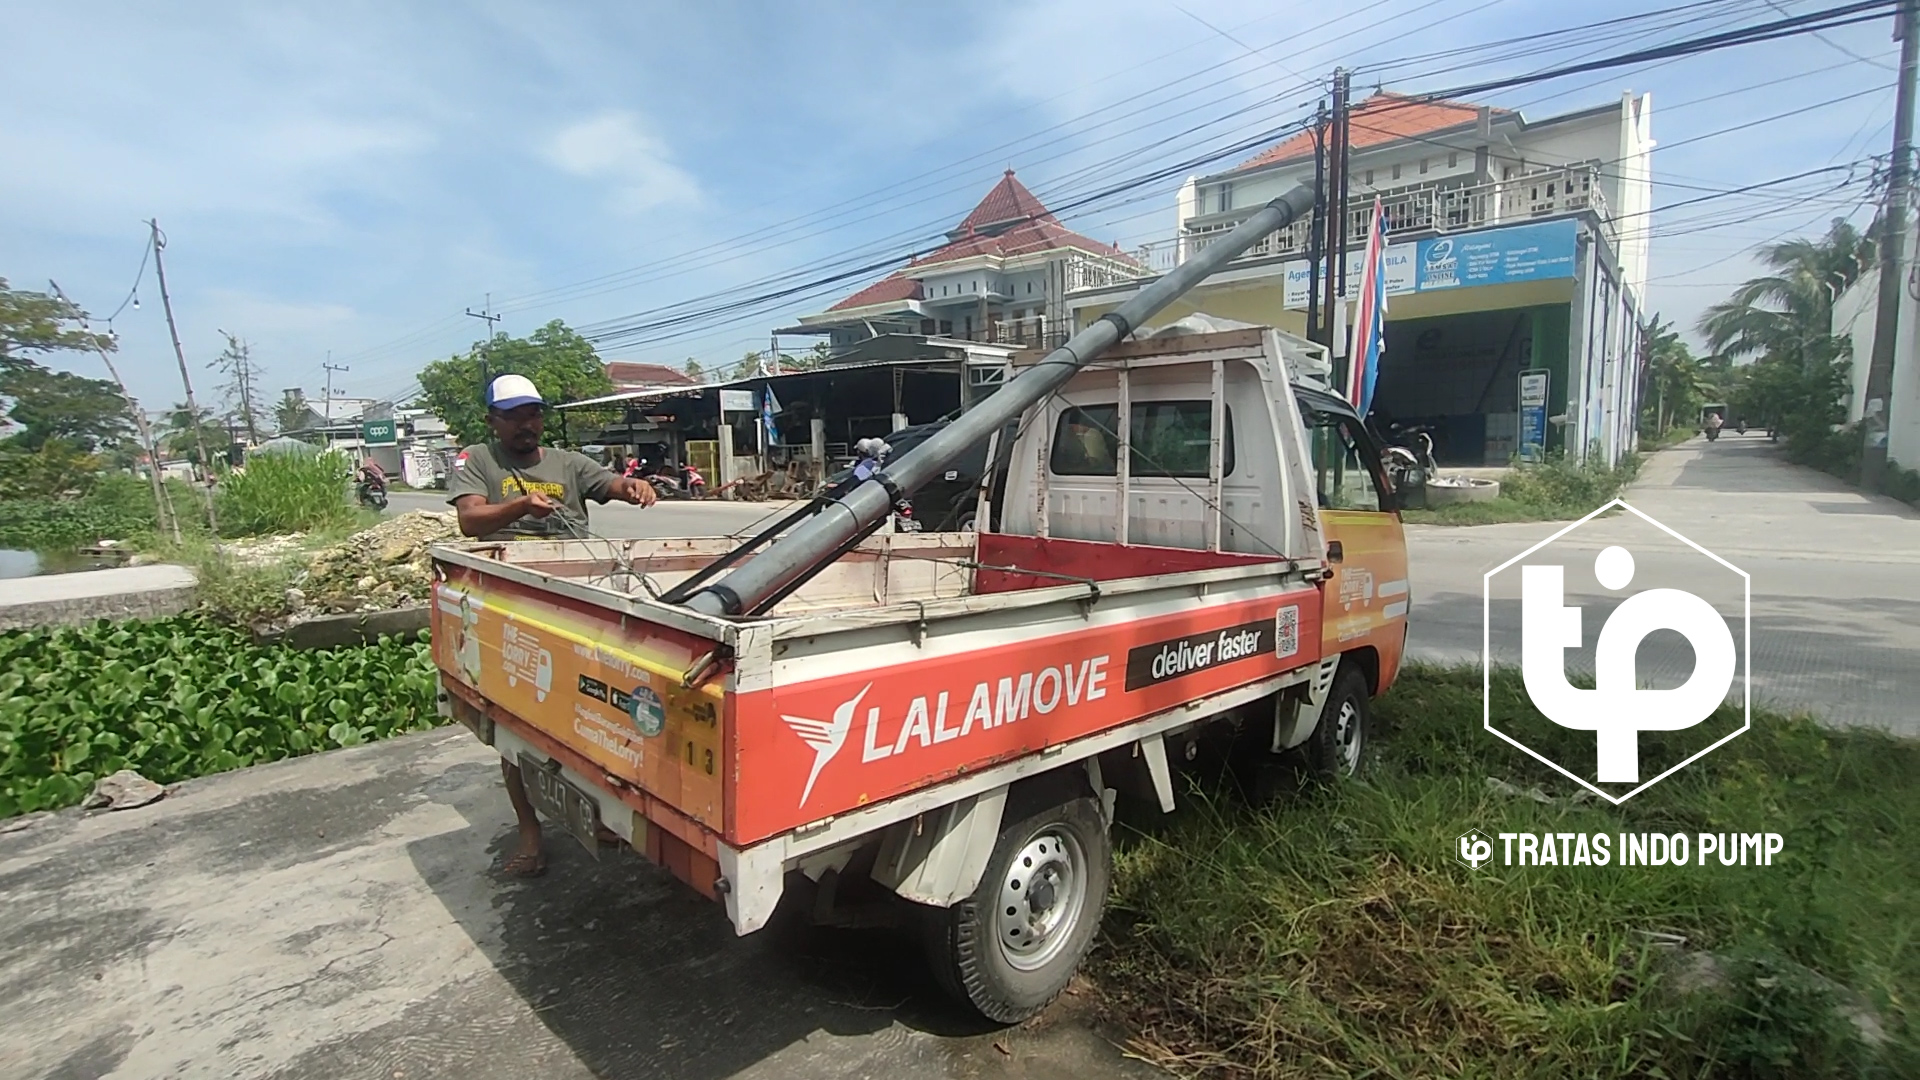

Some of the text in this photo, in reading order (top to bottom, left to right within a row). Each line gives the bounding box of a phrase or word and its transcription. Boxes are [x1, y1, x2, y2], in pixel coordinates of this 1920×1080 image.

[370, 426, 388, 437] oppo
[503, 623, 518, 643] THE
[502, 641, 531, 667] LORRY
[1152, 630, 1261, 679] deliver faster
[862, 655, 1109, 763] LALAMOVE
